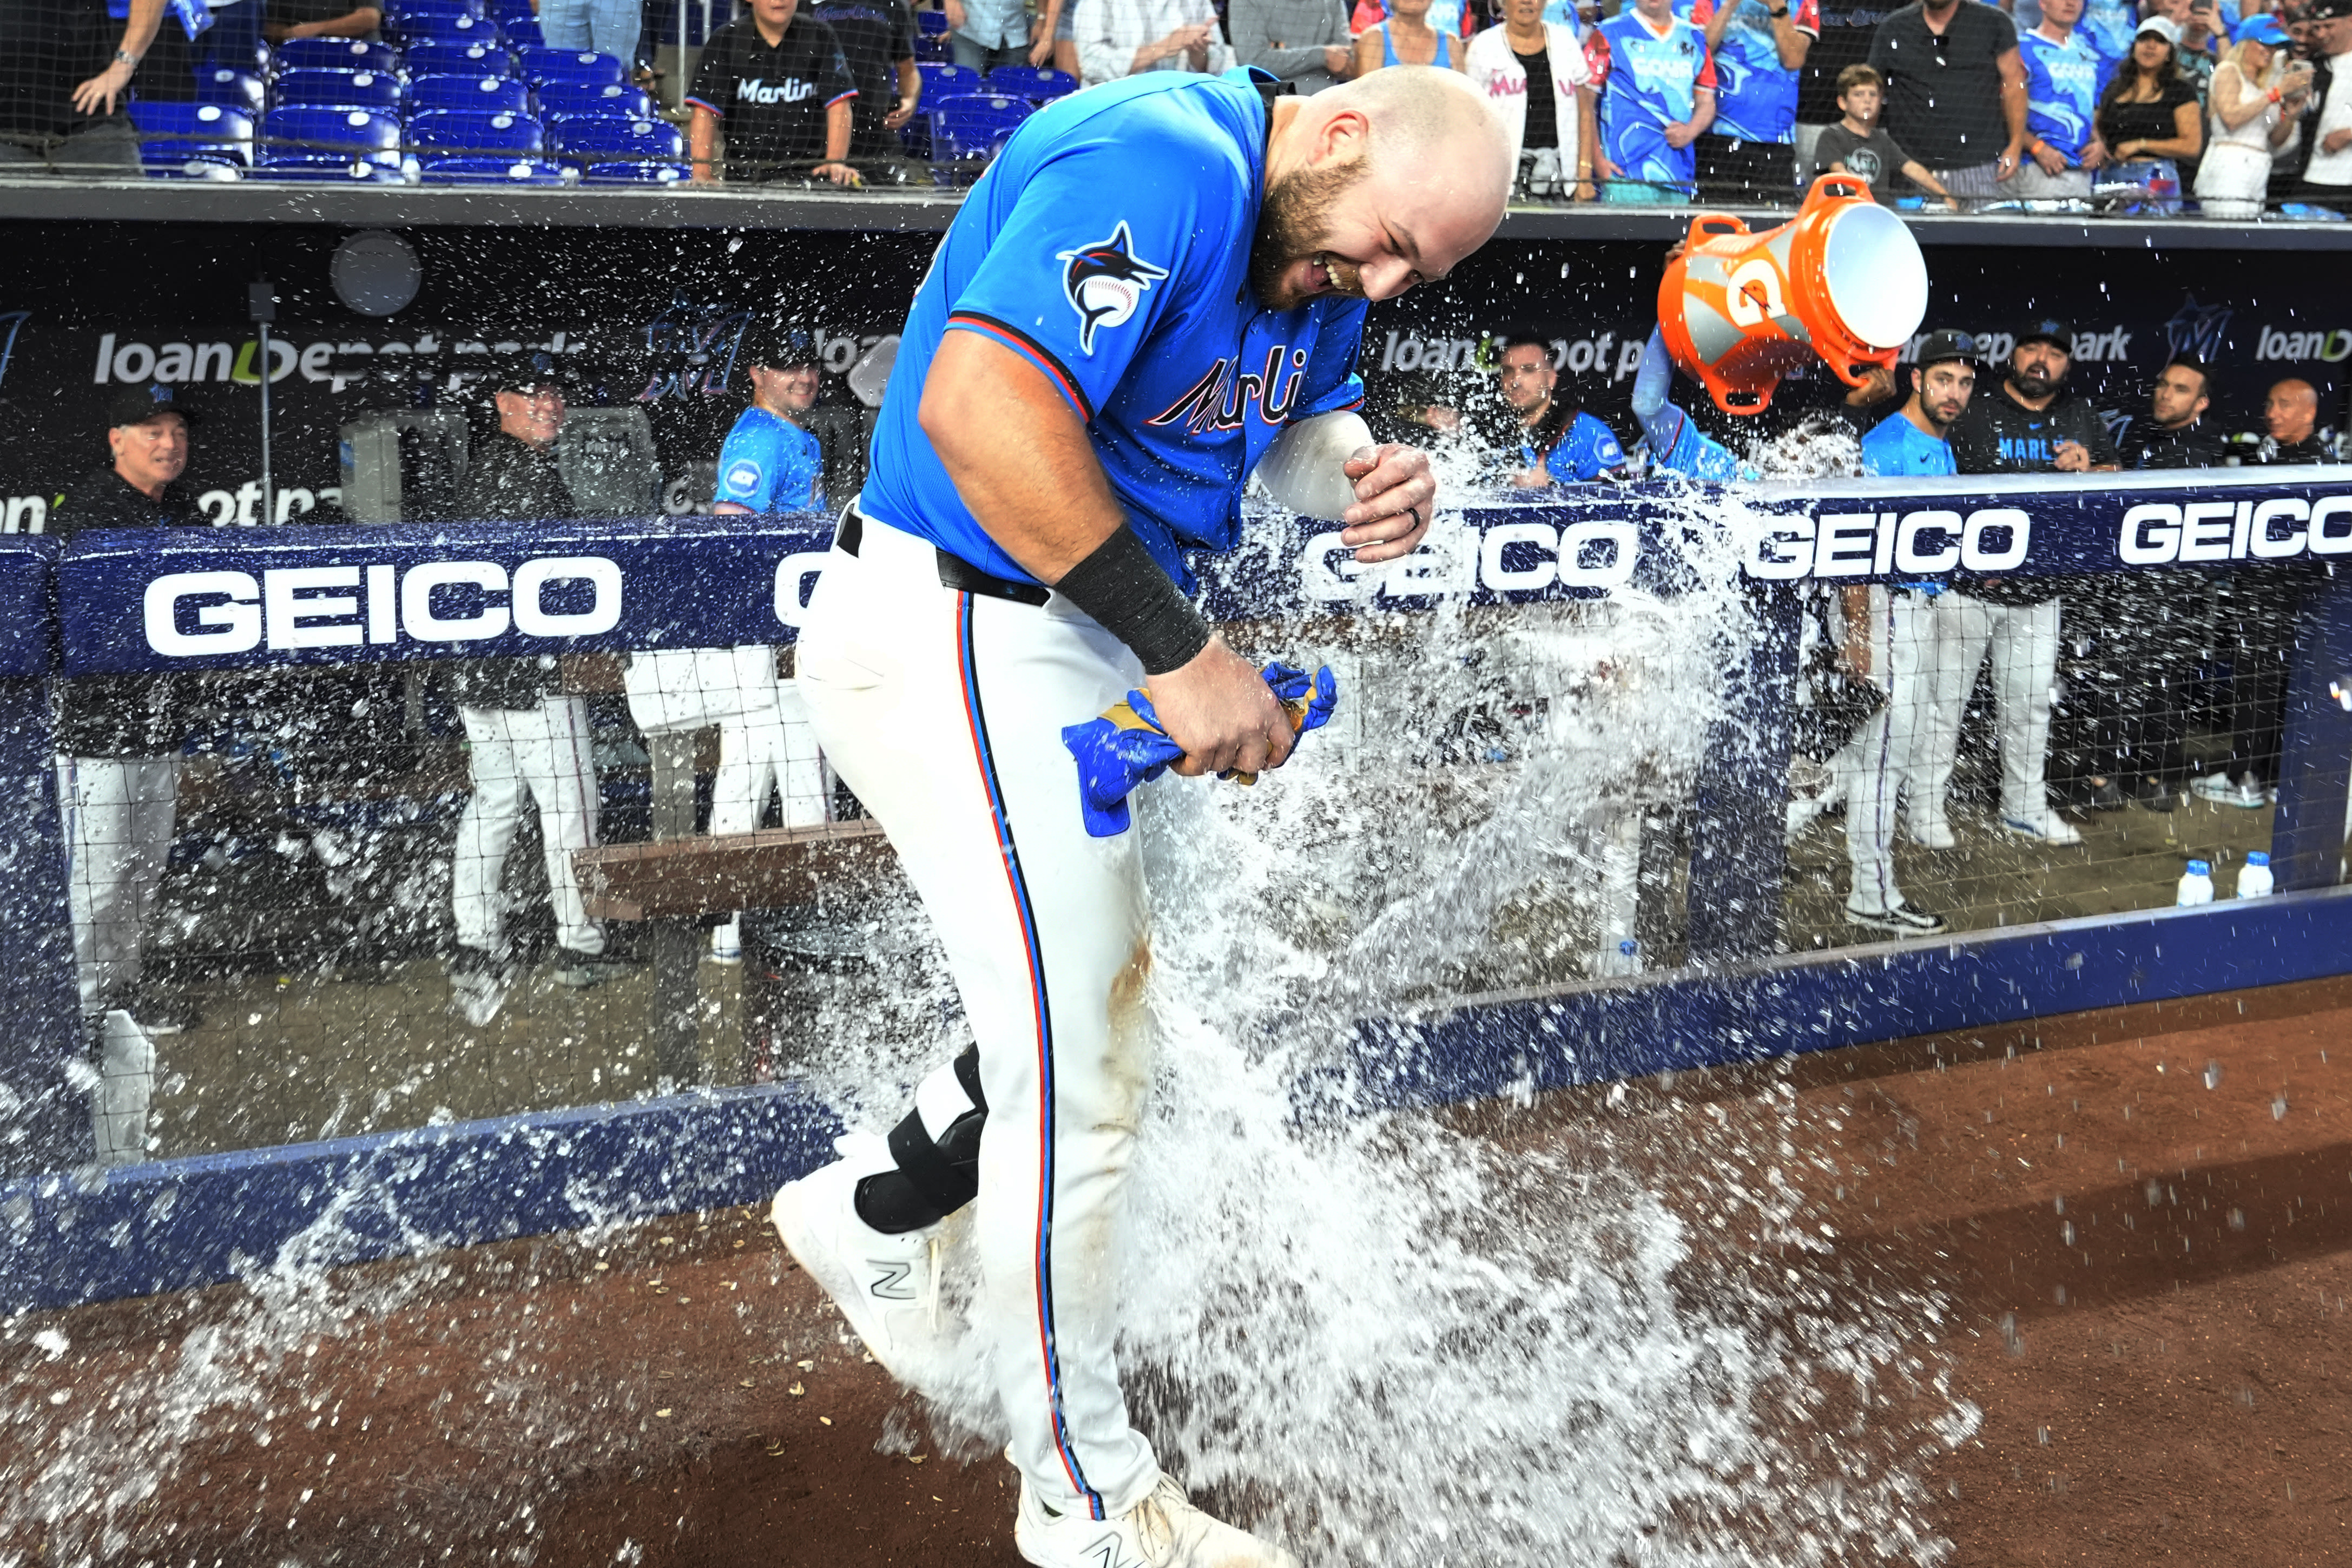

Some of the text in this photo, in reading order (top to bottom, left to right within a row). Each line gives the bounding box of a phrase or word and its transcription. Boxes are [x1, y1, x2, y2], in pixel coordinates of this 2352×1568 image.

[1633, 58, 1694, 77] GOYA
[2071, 325, 2132, 361] ark
[1999, 436, 2075, 461] MARL
[1301, 520, 1639, 601] GEICO
[1744, 509, 2031, 579] GEICO
[2119, 495, 2352, 565] GEICO
[143, 556, 622, 656] GEICO
